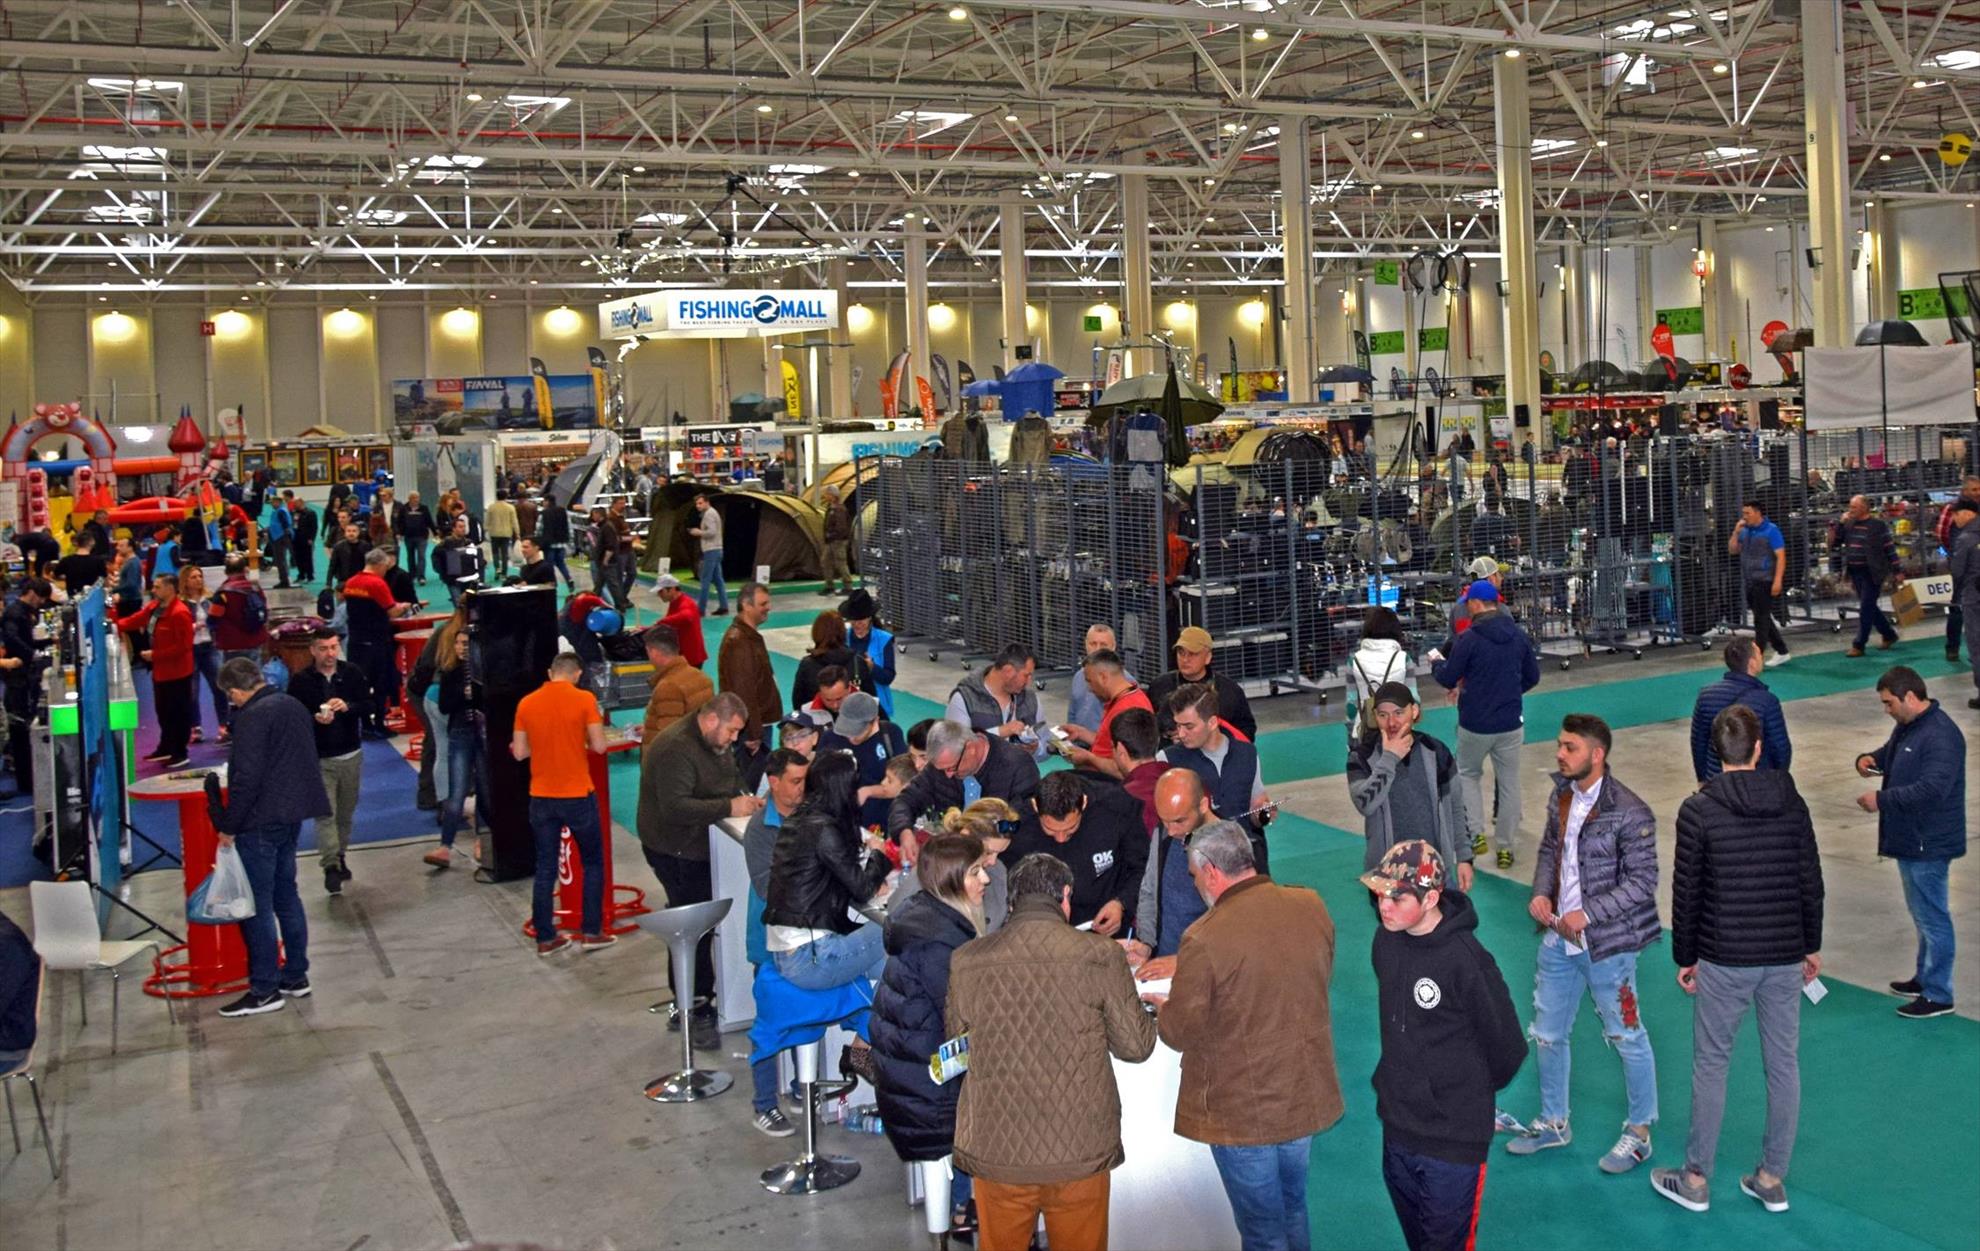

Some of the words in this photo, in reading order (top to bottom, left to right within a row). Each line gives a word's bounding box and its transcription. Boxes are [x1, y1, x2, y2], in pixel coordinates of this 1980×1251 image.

[680, 300, 753, 319] FISHING
[780, 300, 827, 318] MALL
[691, 433, 711, 443] THE
